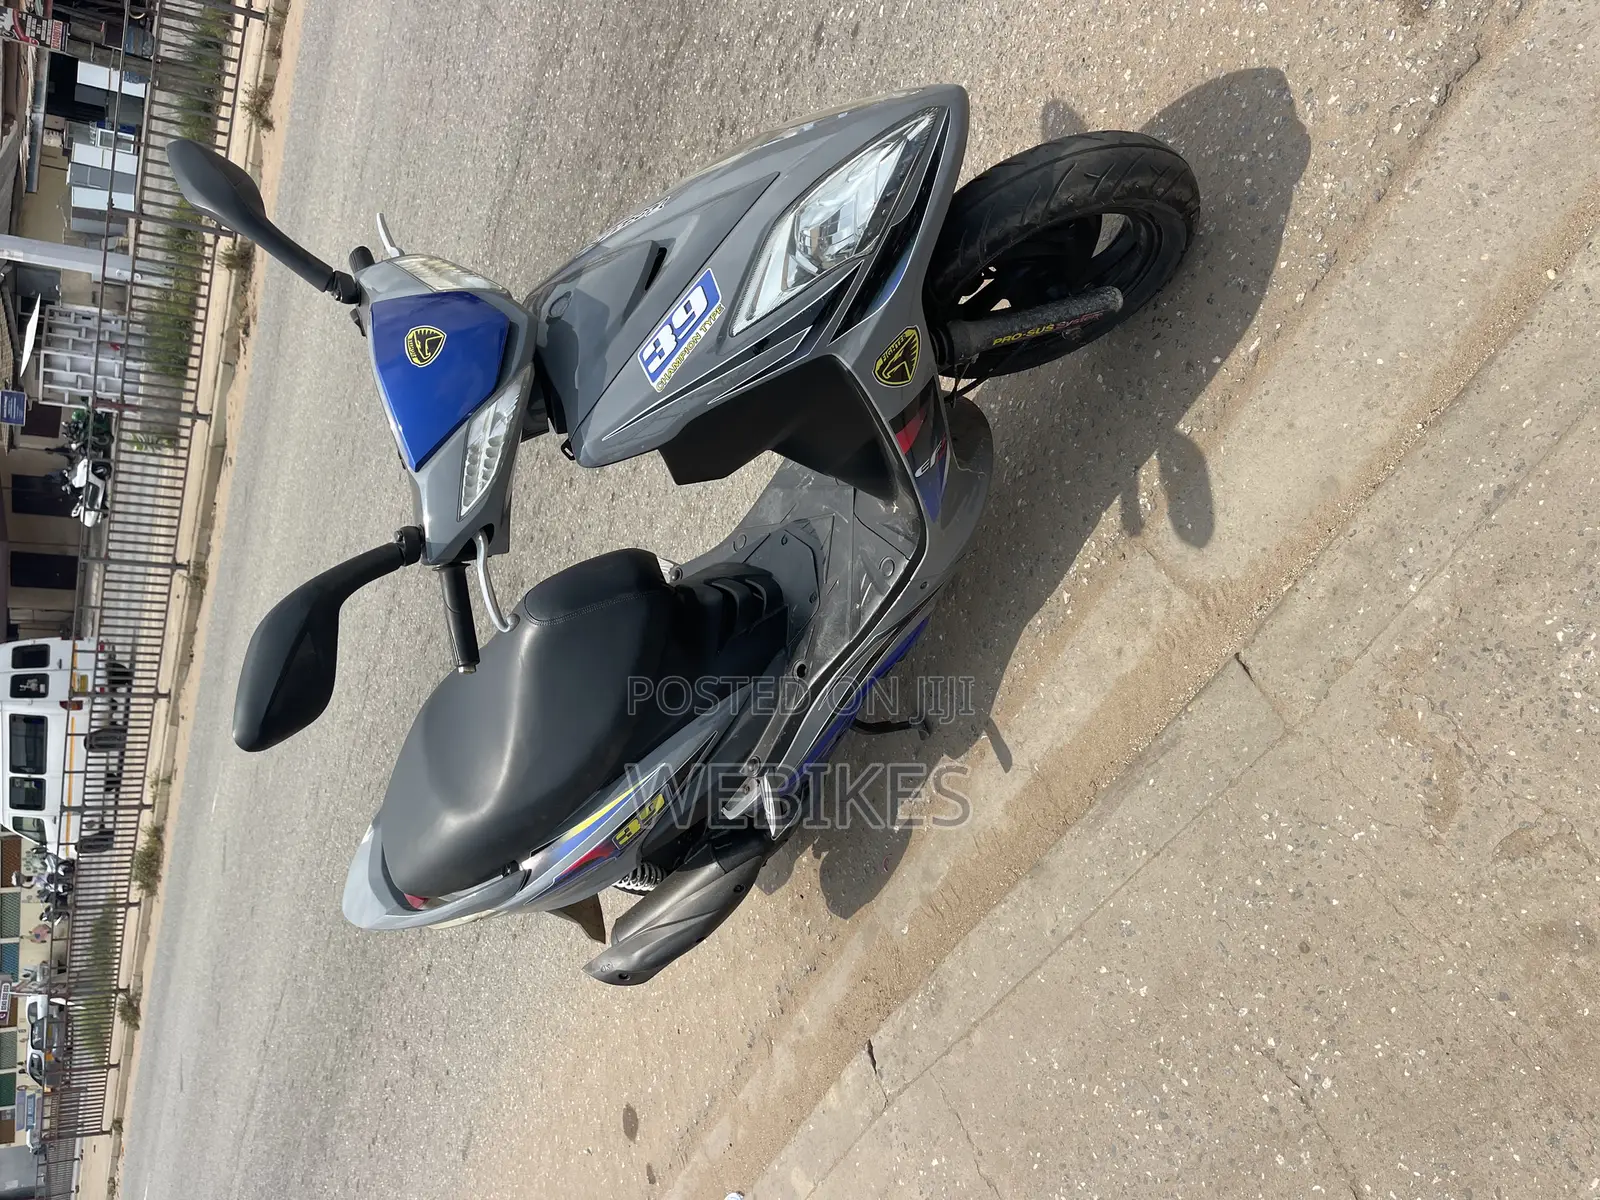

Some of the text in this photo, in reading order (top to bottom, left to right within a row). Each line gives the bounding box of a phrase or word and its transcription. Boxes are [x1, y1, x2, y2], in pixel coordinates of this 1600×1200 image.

[642, 285, 709, 374] 39
[655, 305, 725, 392] CHAMPION TYPE
[880, 332, 907, 362] FIGHTER
[992, 323, 1055, 346] PRO-SUS
[615, 793, 665, 846] 39
